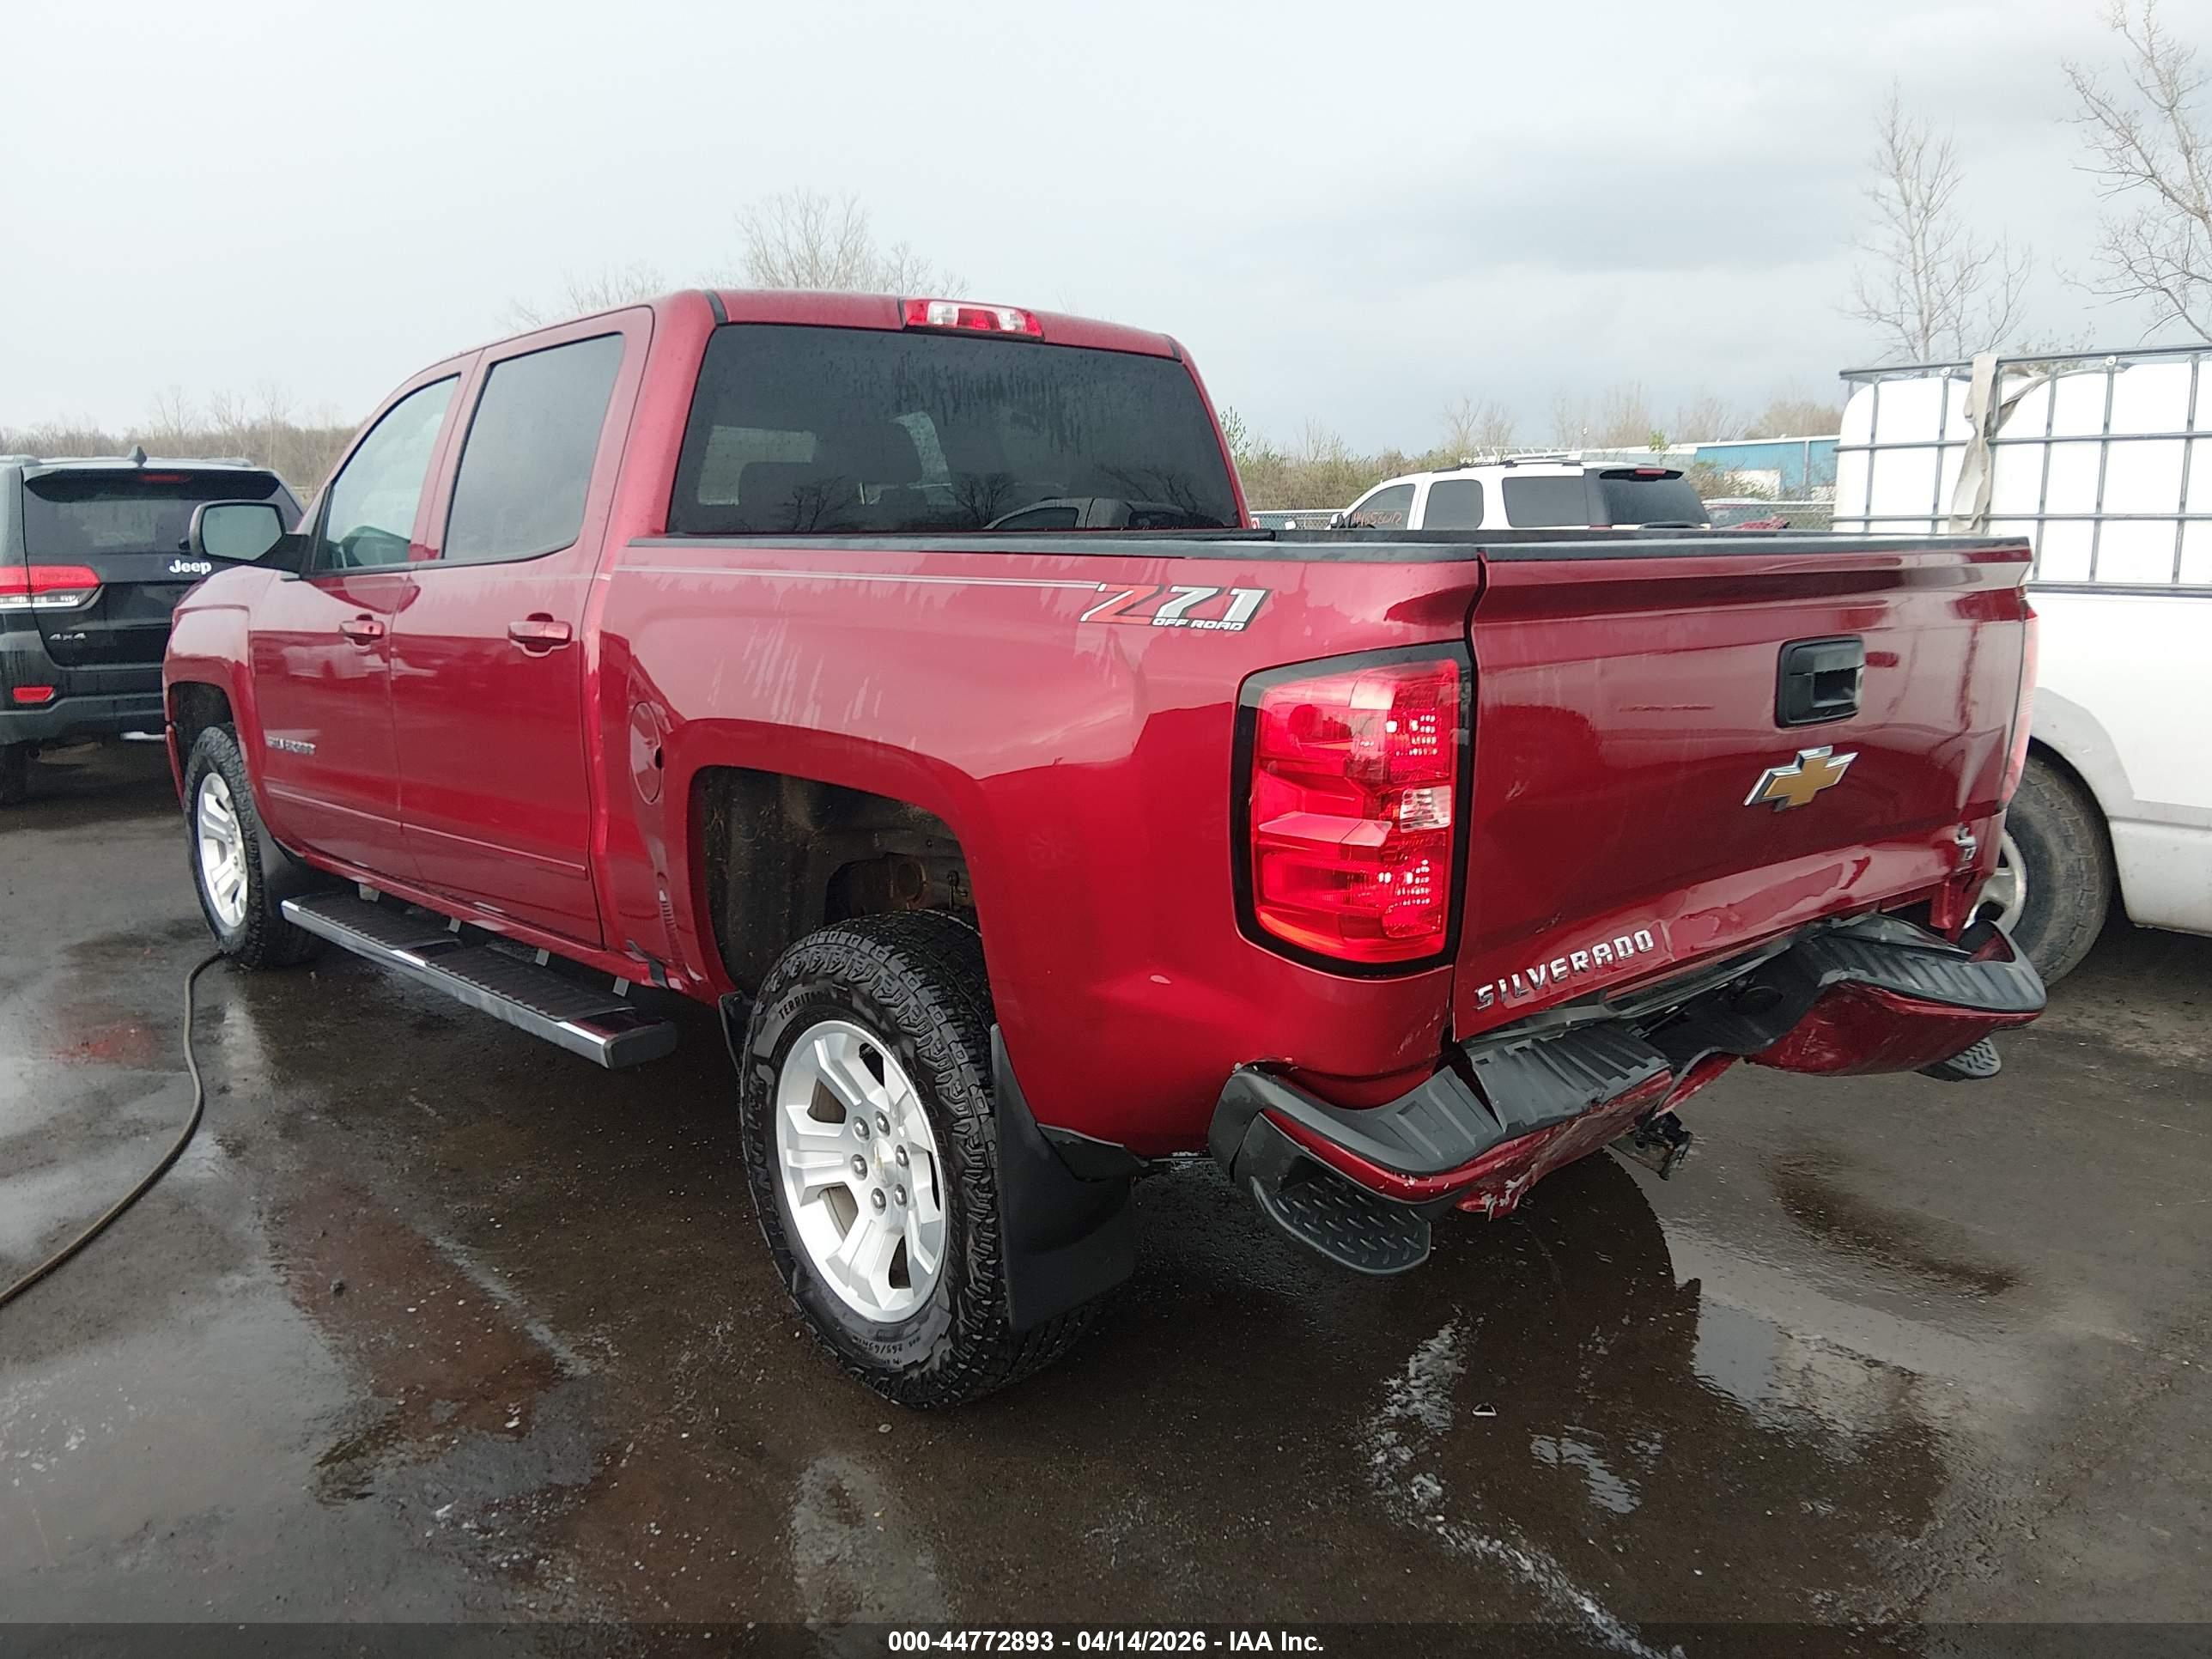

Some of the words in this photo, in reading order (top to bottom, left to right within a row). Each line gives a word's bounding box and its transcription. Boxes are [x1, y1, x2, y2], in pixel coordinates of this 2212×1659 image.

[168, 559, 212, 575] Jeep
[1079, 582, 1272, 625] Z71
[1152, 617, 1188, 628] OFF
[1189, 619, 1246, 632] ROAD
[49, 632, 87, 641] 4x4
[1474, 928, 1655, 1011] SILVERADO
